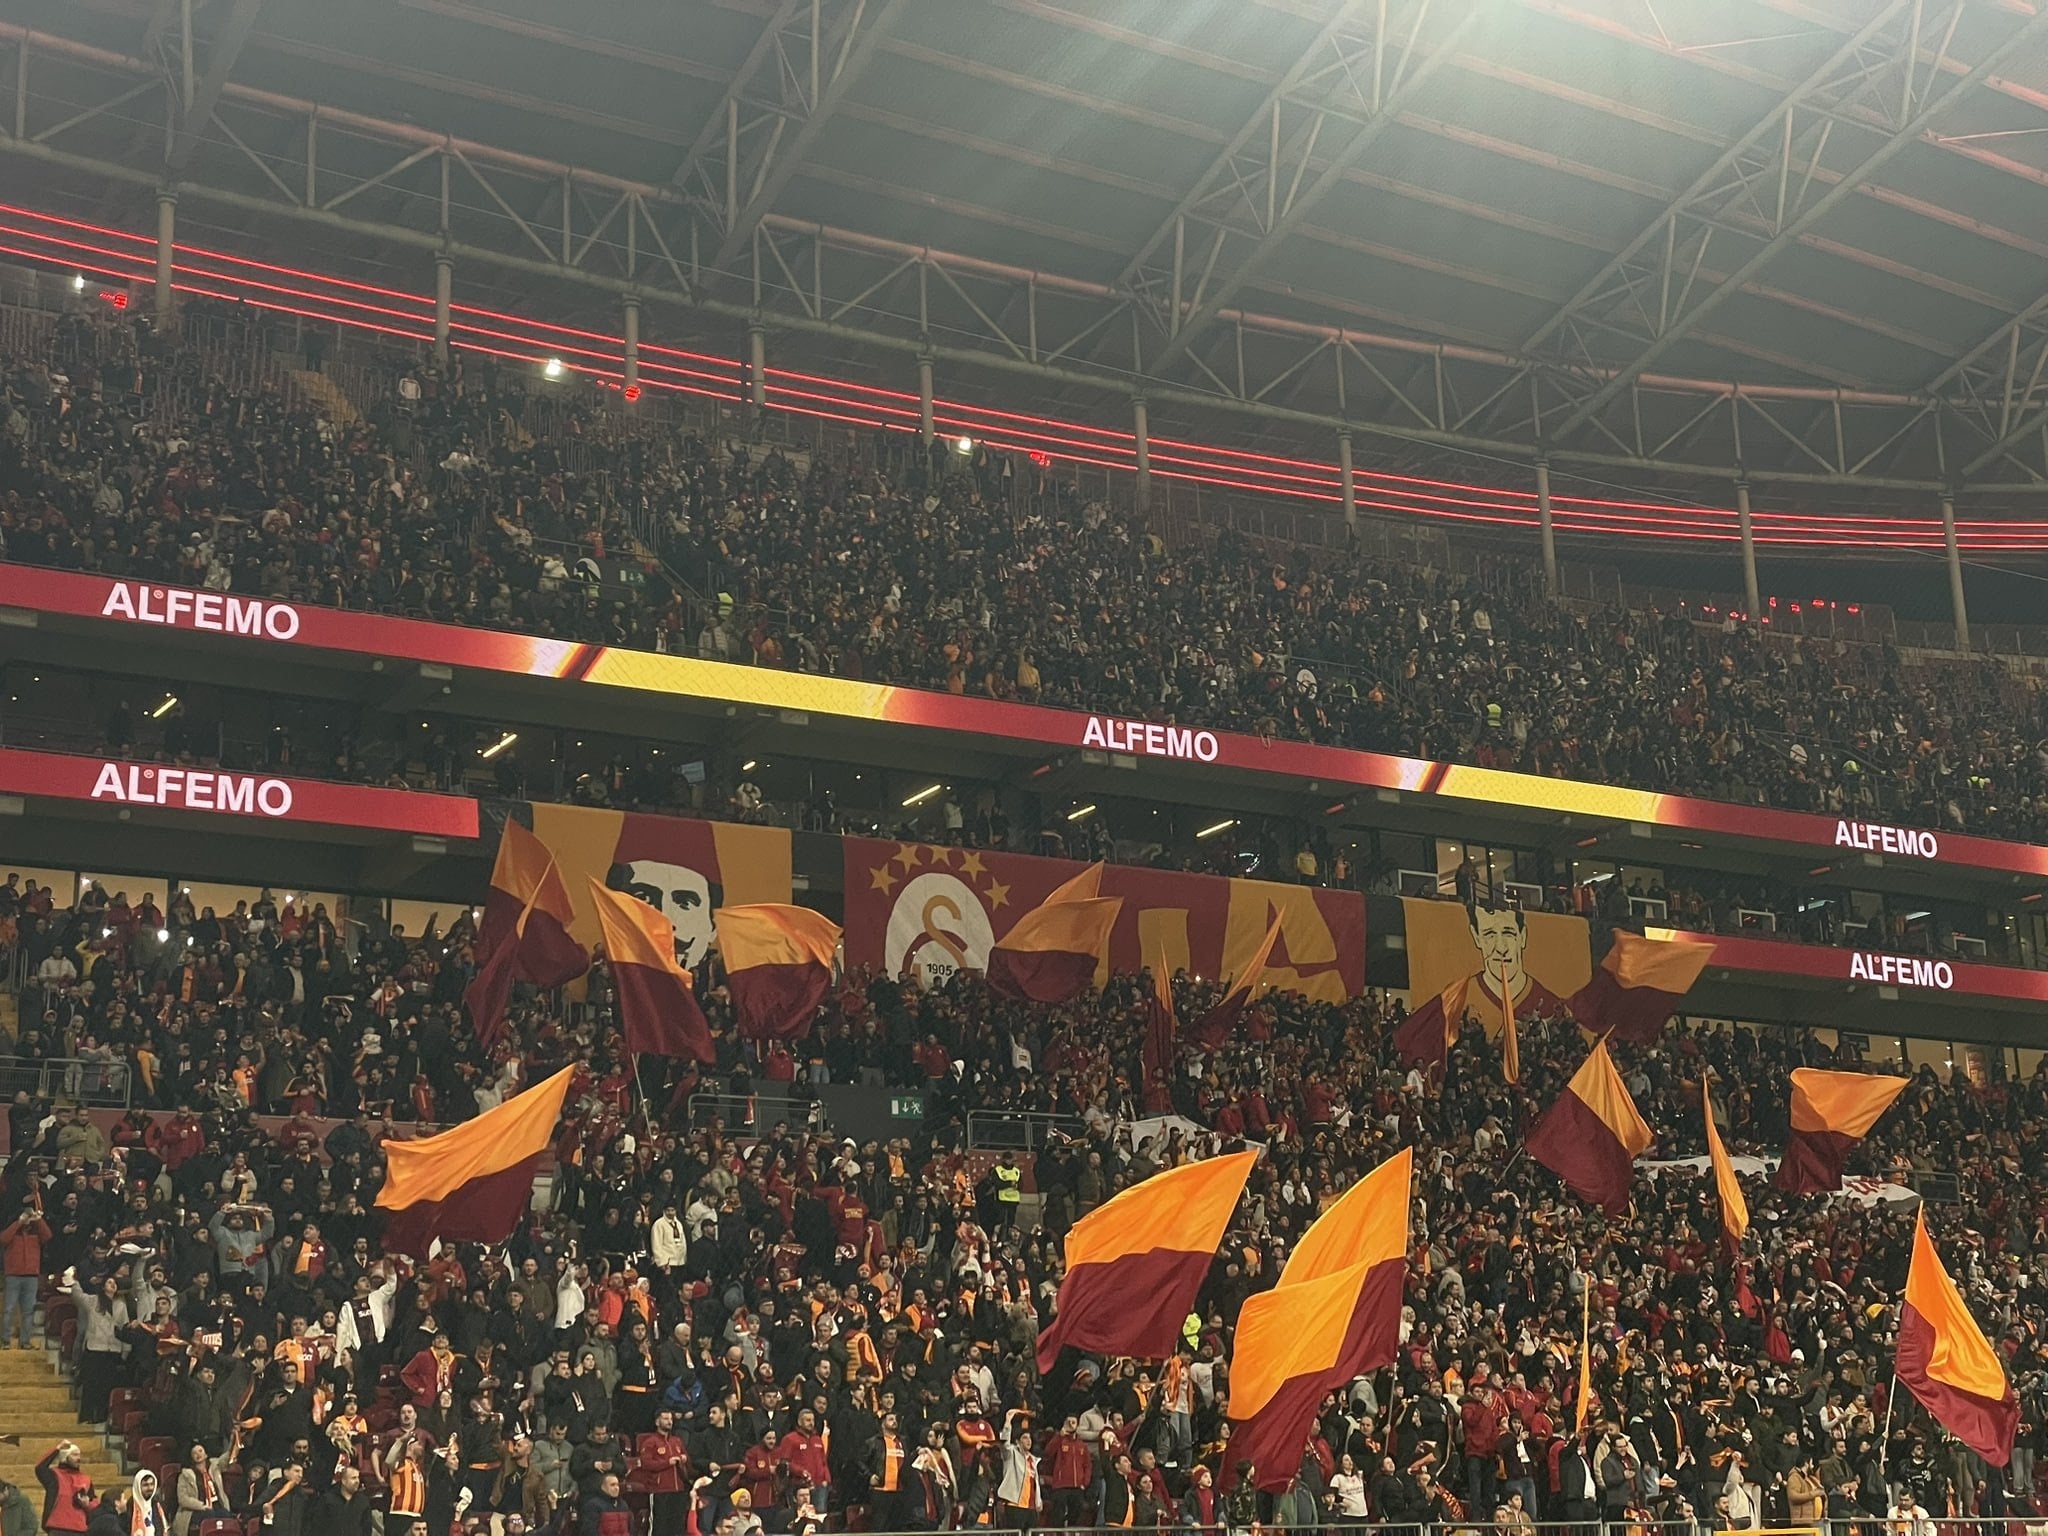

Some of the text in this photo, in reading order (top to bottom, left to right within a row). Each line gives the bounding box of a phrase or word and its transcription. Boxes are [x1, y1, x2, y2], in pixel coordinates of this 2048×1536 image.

[102, 582, 299, 640] ALFEMO
[1082, 716, 1218, 762] ALFEMO
[91, 763, 293, 816] ALFEMO
[1835, 820, 1938, 858] ALFEMO
[927, 962, 953, 977] 1905
[1850, 952, 1954, 989] ALFEMO
